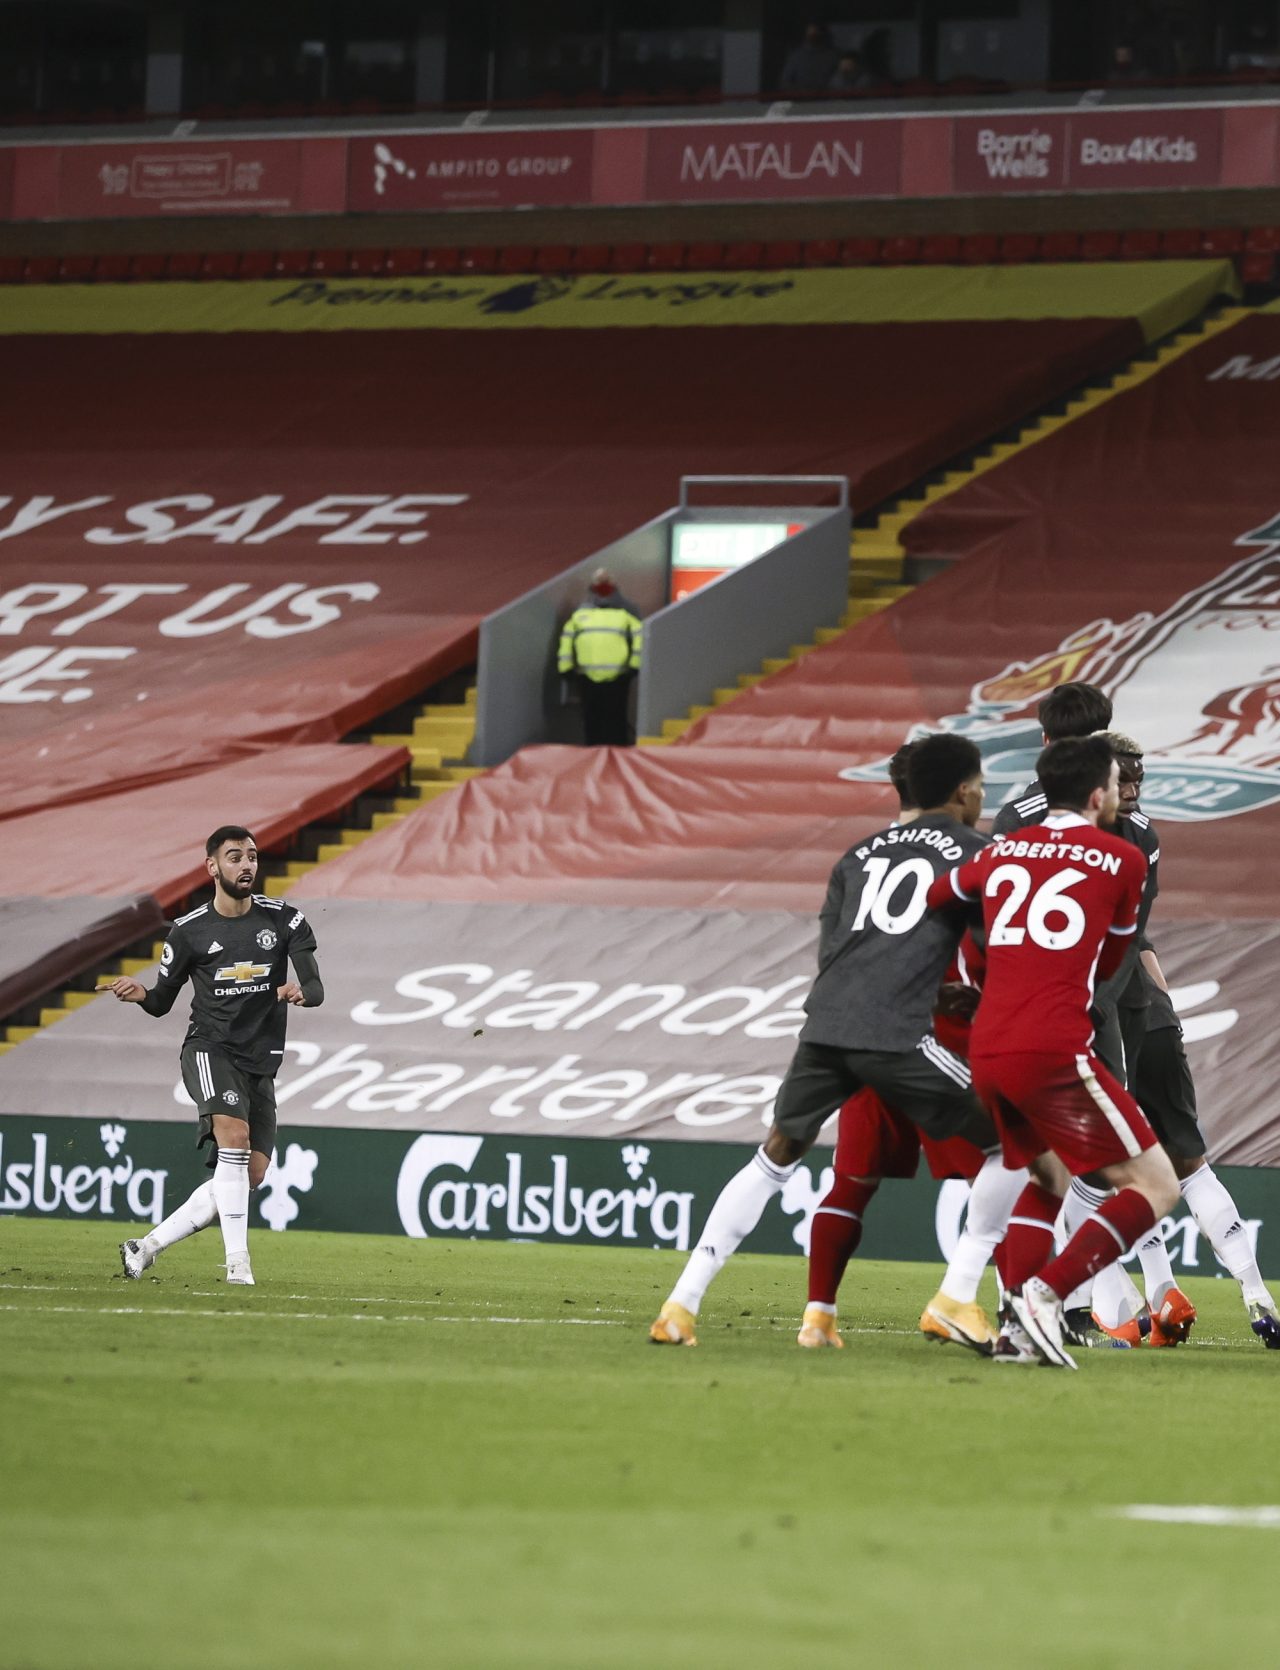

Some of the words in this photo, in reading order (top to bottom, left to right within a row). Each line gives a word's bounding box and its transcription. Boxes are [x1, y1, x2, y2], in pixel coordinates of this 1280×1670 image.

[426, 159, 497, 178] AMPITO
[504, 157, 569, 176] GROUP
[681, 140, 862, 182] MATALAN
[978, 129, 1052, 155] Barrie
[985, 152, 1049, 179] Wells
[1080, 136, 1196, 165] Box4Kids
[84, 494, 469, 545] SAFE.
[159, 582, 380, 639] US
[854, 828, 963, 862] RASHFORD
[851, 857, 935, 935] 10
[985, 863, 1088, 950] 26
[214, 982, 271, 996] CHEVROLET
[350, 963, 812, 1040] Standa
[174, 1041, 778, 1127] hartere
[0, 1131, 169, 1226] sberg
[396, 1133, 695, 1251] Carlsberg
